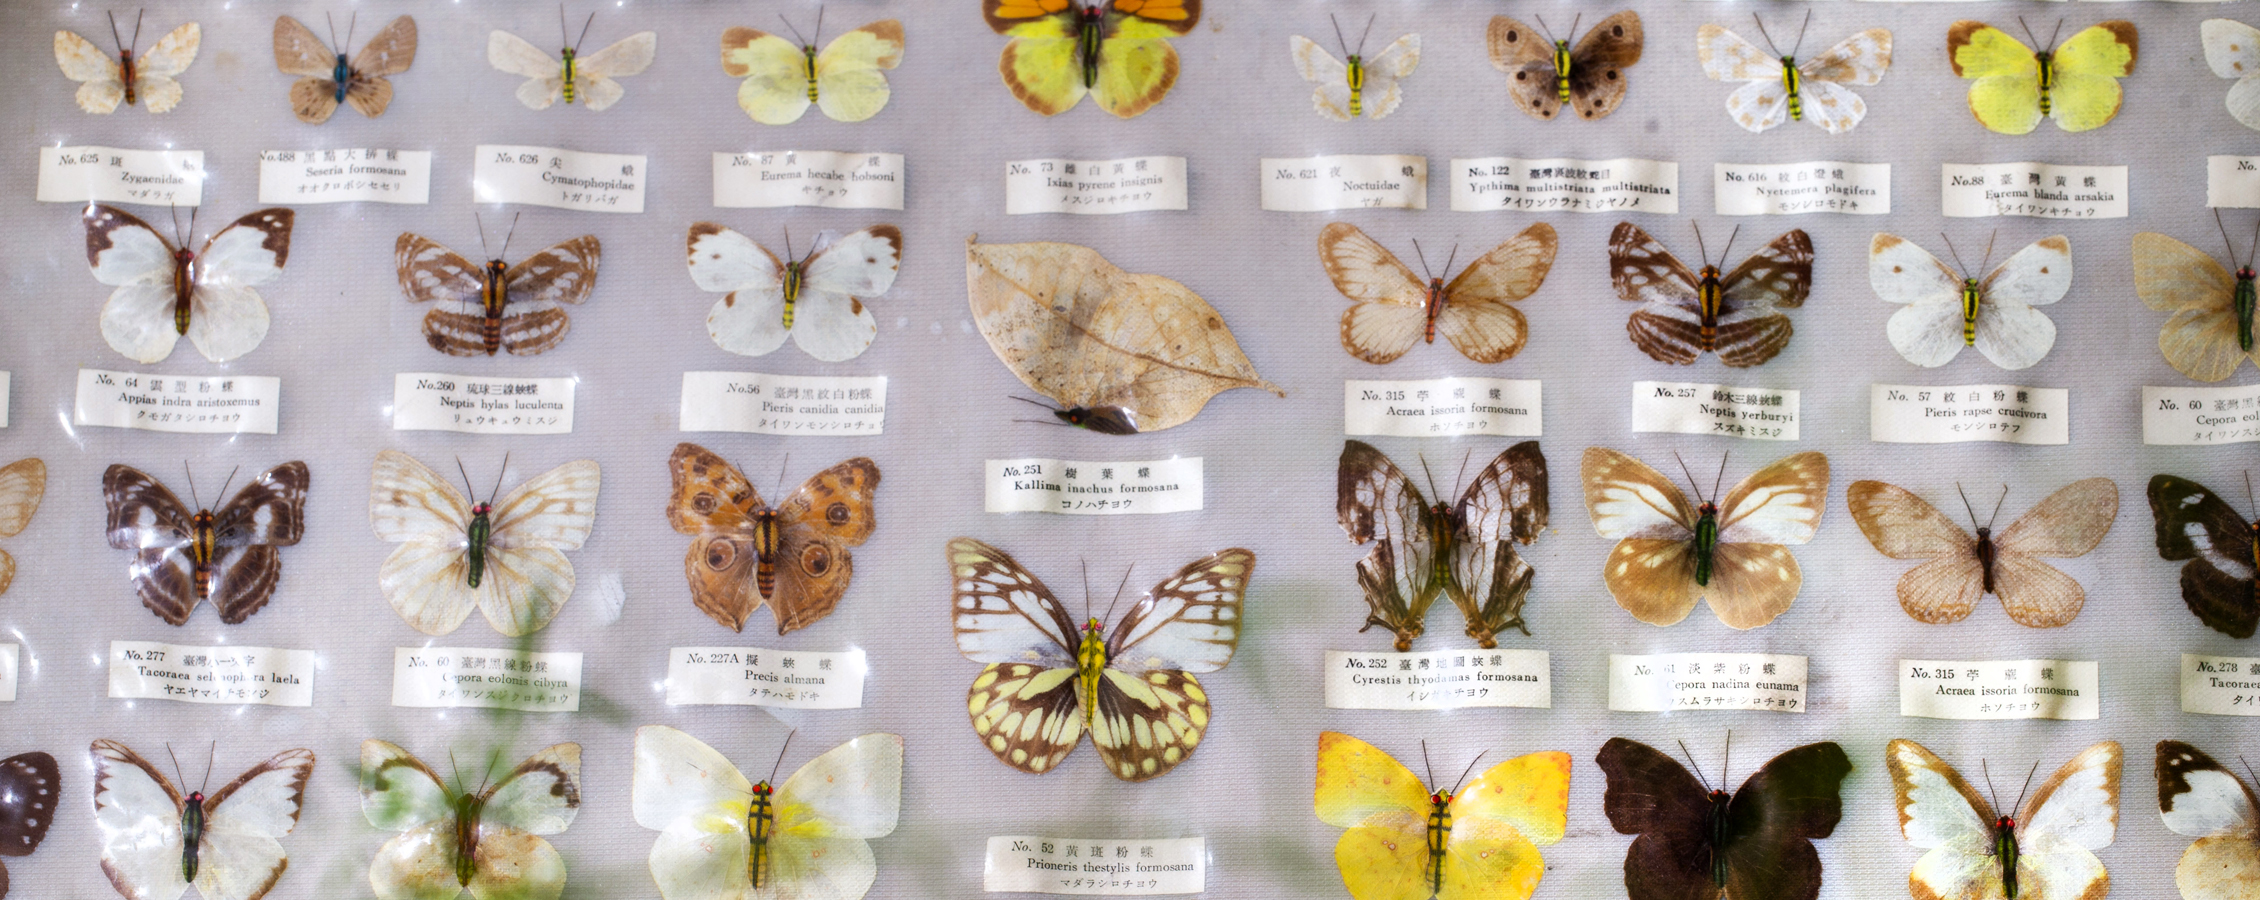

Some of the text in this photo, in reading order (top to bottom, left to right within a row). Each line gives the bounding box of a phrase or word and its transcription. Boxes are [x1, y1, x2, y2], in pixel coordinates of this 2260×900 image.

[59, 155, 76, 165] No.
[80, 154, 99, 163] 625
[495, 153, 514, 163] No.
[519, 154, 538, 164] 626
[732, 156, 752, 166] No.
[761, 155, 774, 165] 87
[306, 164, 406, 177] Seseria formosana
[1010, 162, 1053, 175] No. 73
[1469, 166, 1509, 177] No. 122
[2238, 161, 2257, 170] No.
[122, 172, 183, 184] Zygaenidae
[761, 169, 894, 181] Eurema hecabe hobsoni
[1276, 169, 1295, 179] No.
[1299, 169, 1317, 179] 621
[1726, 172, 1767, 181] No. 616
[542, 170, 634, 191] Cymatophopidae
[1048, 175, 1163, 191] Ixias pyrene insignis
[1344, 181, 1400, 191] Noctuidae
[1470, 182, 1670, 194] Ypthima multistriata multistriata
[1825, 184, 1876, 196] plagifera
[1986, 189, 2114, 201] Eurema blanda arsakia
[96, 375, 115, 385] No.
[125, 378, 137, 387] 64
[1362, 391, 1405, 400] No. 315
[1655, 388, 1674, 397] No.
[1678, 389, 1696, 397] 257
[1888, 390, 1908, 401] No.
[1919, 392, 1931, 401] 57
[118, 393, 260, 407] Appias indra aristoxemus
[440, 396, 563, 411] Neptis hylas luculenta
[2159, 400, 2179, 410] No.
[2189, 400, 2202, 409] 60
[763, 402, 886, 414] Pieris canidia canidia
[1387, 403, 1527, 416] Acraea issoria formosana
[1700, 404, 1793, 423] Neptis yerburyi
[1926, 408, 1956, 417] Pieris
[1998, 408, 2047, 419] crucivora
[2196, 415, 2236, 426] Cepora
[1003, 467, 1021, 476] No.
[1024, 465, 1041, 474] 251
[1015, 480, 1179, 493] Kallima inachus formosana
[124, 650, 165, 661] No. 277
[687, 653, 706, 663] No.
[711, 654, 739, 663] 227A
[409, 657, 428, 667] No.
[1346, 658, 1365, 668] No.
[1369, 659, 1387, 668] 252
[2197, 661, 2238, 672] No. 278
[138, 666, 299, 684] Tacoraea selnophra laela
[1634, 665, 1653, 675] No.
[1911, 668, 1931, 678] No.
[1935, 669, 1954, 679] 315
[745, 670, 825, 684] Precis almana
[1353, 672, 1538, 686] Cyrestis thyodamas formosana
[534, 678, 568, 690] cibyra
[1712, 679, 1750, 688] nadina
[1756, 682, 1799, 691] eunama
[1936, 684, 2079, 696] Acraea issoria formosana
[749, 688, 819, 701] タテハモドキ
[1012, 841, 1031, 851] No.
[1042, 843, 1053, 853] 52
[1027, 858, 1194, 874] Prioneris thestylis formosana
